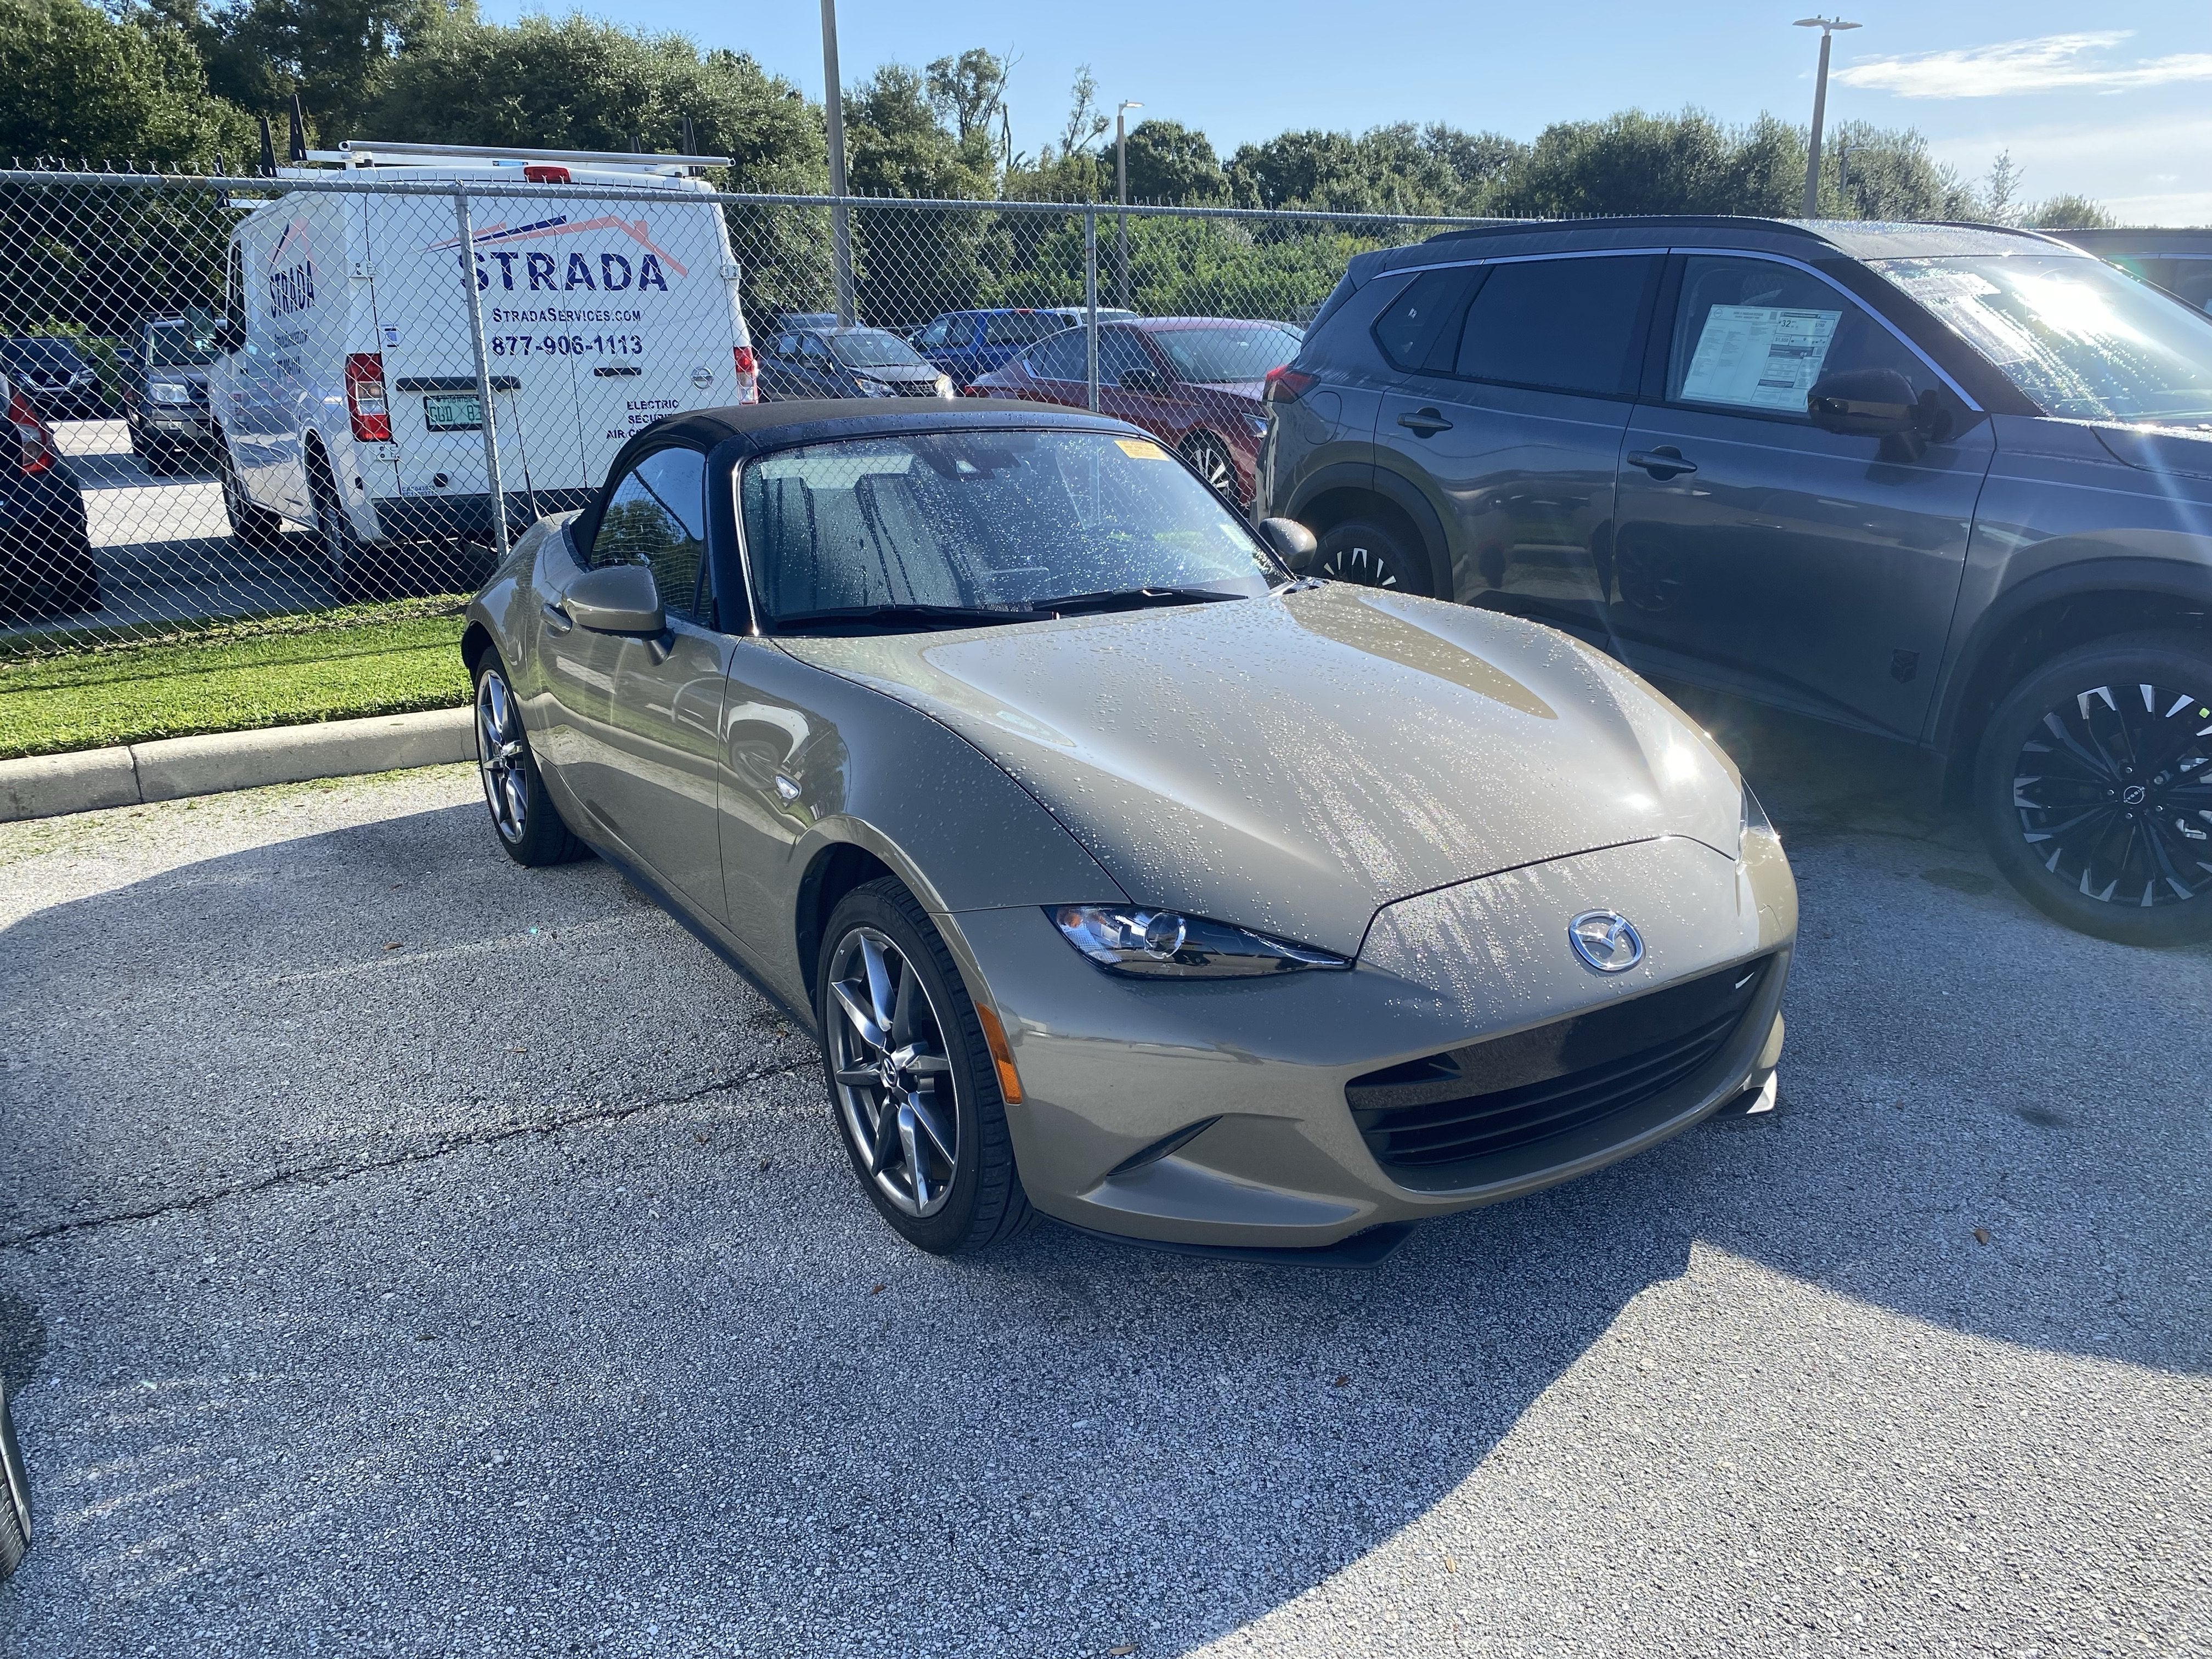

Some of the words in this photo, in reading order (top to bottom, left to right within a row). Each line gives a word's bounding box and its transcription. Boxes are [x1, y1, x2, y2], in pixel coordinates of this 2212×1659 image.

[458, 252, 668, 291] STRADA
[269, 261, 315, 318] STRADA
[493, 335, 642, 356] 877-906-1113
[627, 399, 679, 410] ELECTRIC
[628, 414, 673, 424] SECUR
[606, 430, 626, 439] AIR
[629, 428, 641, 437] C
